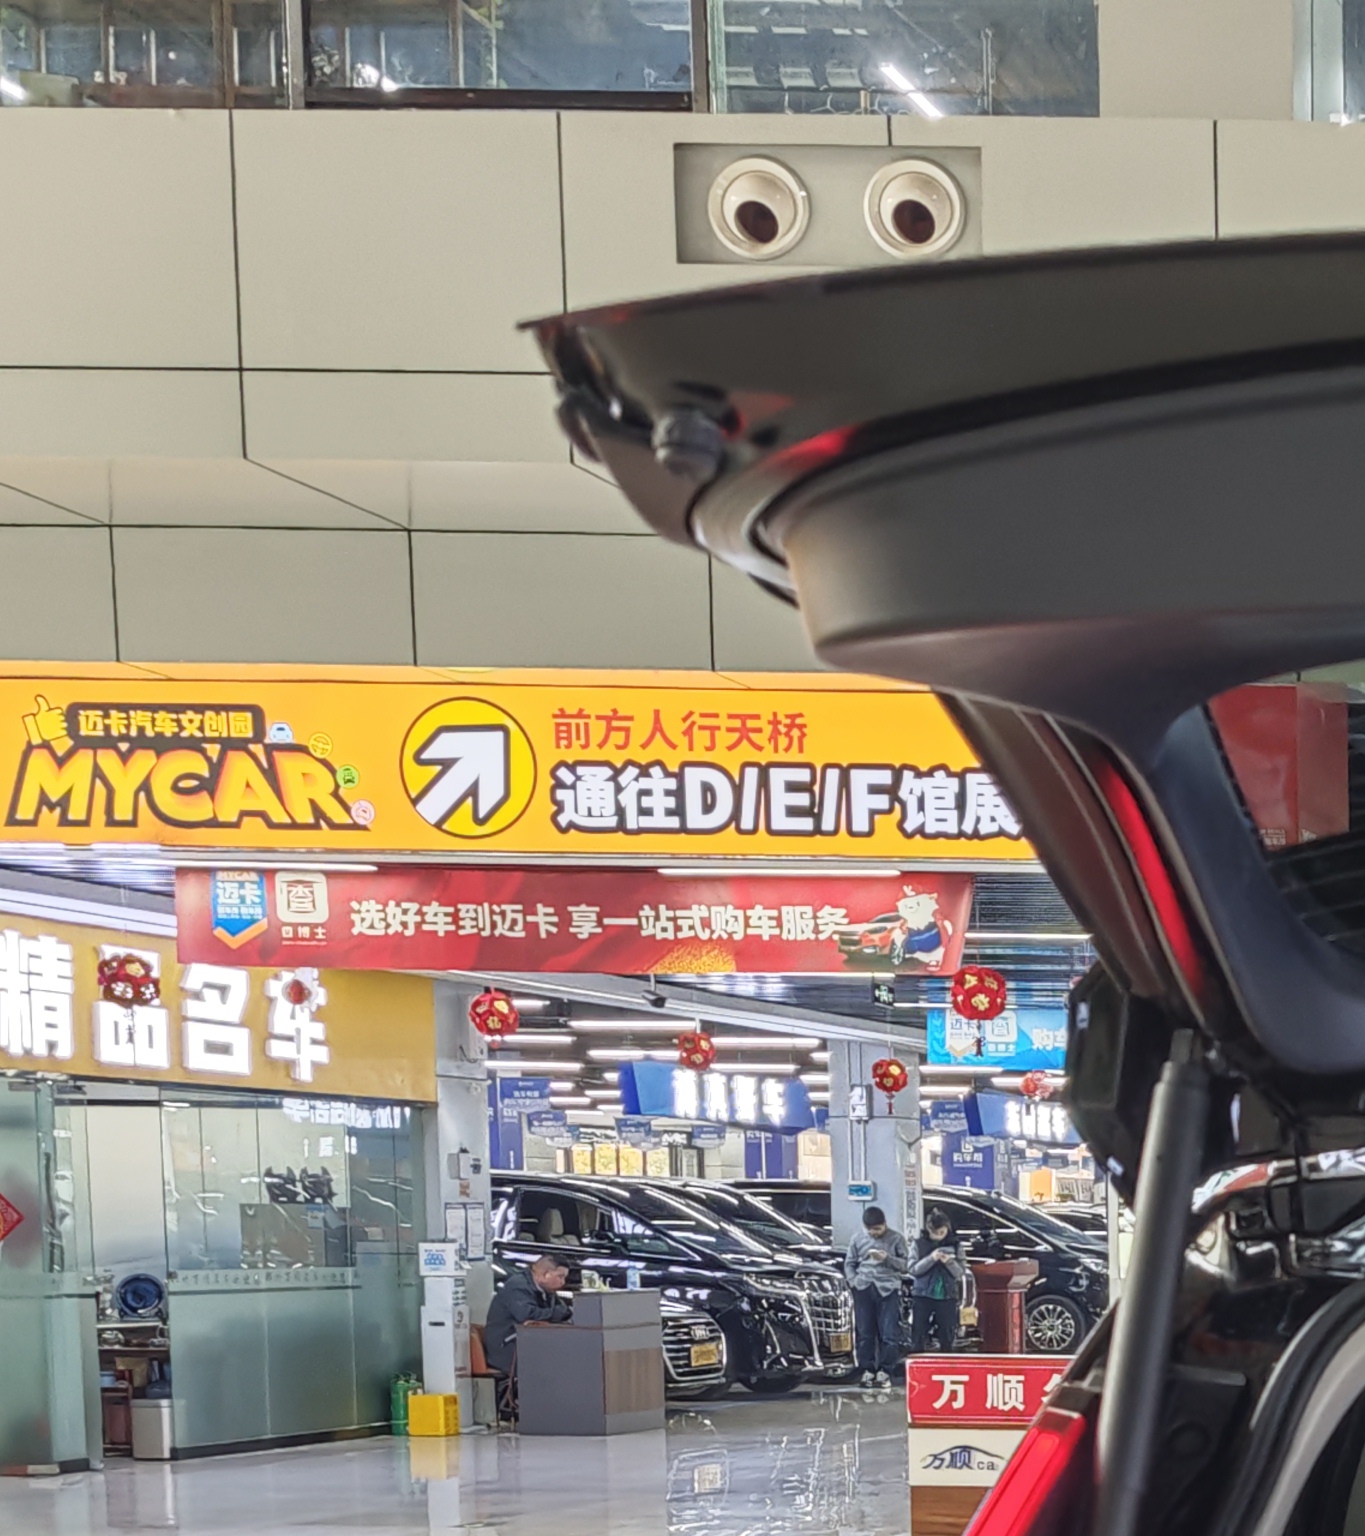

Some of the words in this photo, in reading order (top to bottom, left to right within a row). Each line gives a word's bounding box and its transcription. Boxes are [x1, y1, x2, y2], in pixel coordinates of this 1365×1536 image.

[78, 709, 254, 739] 迈卡汽车文创园
[552, 708, 808, 754] 前方人行天桥
[9, 745, 358, 827] MYCAR
[215, 881, 262, 905] 迈卡
[350, 899, 560, 940] 选好车到迈卡
[568, 902, 851, 942] 享一站式购车服务
[0, 928, 330, 1083] 精品名车
